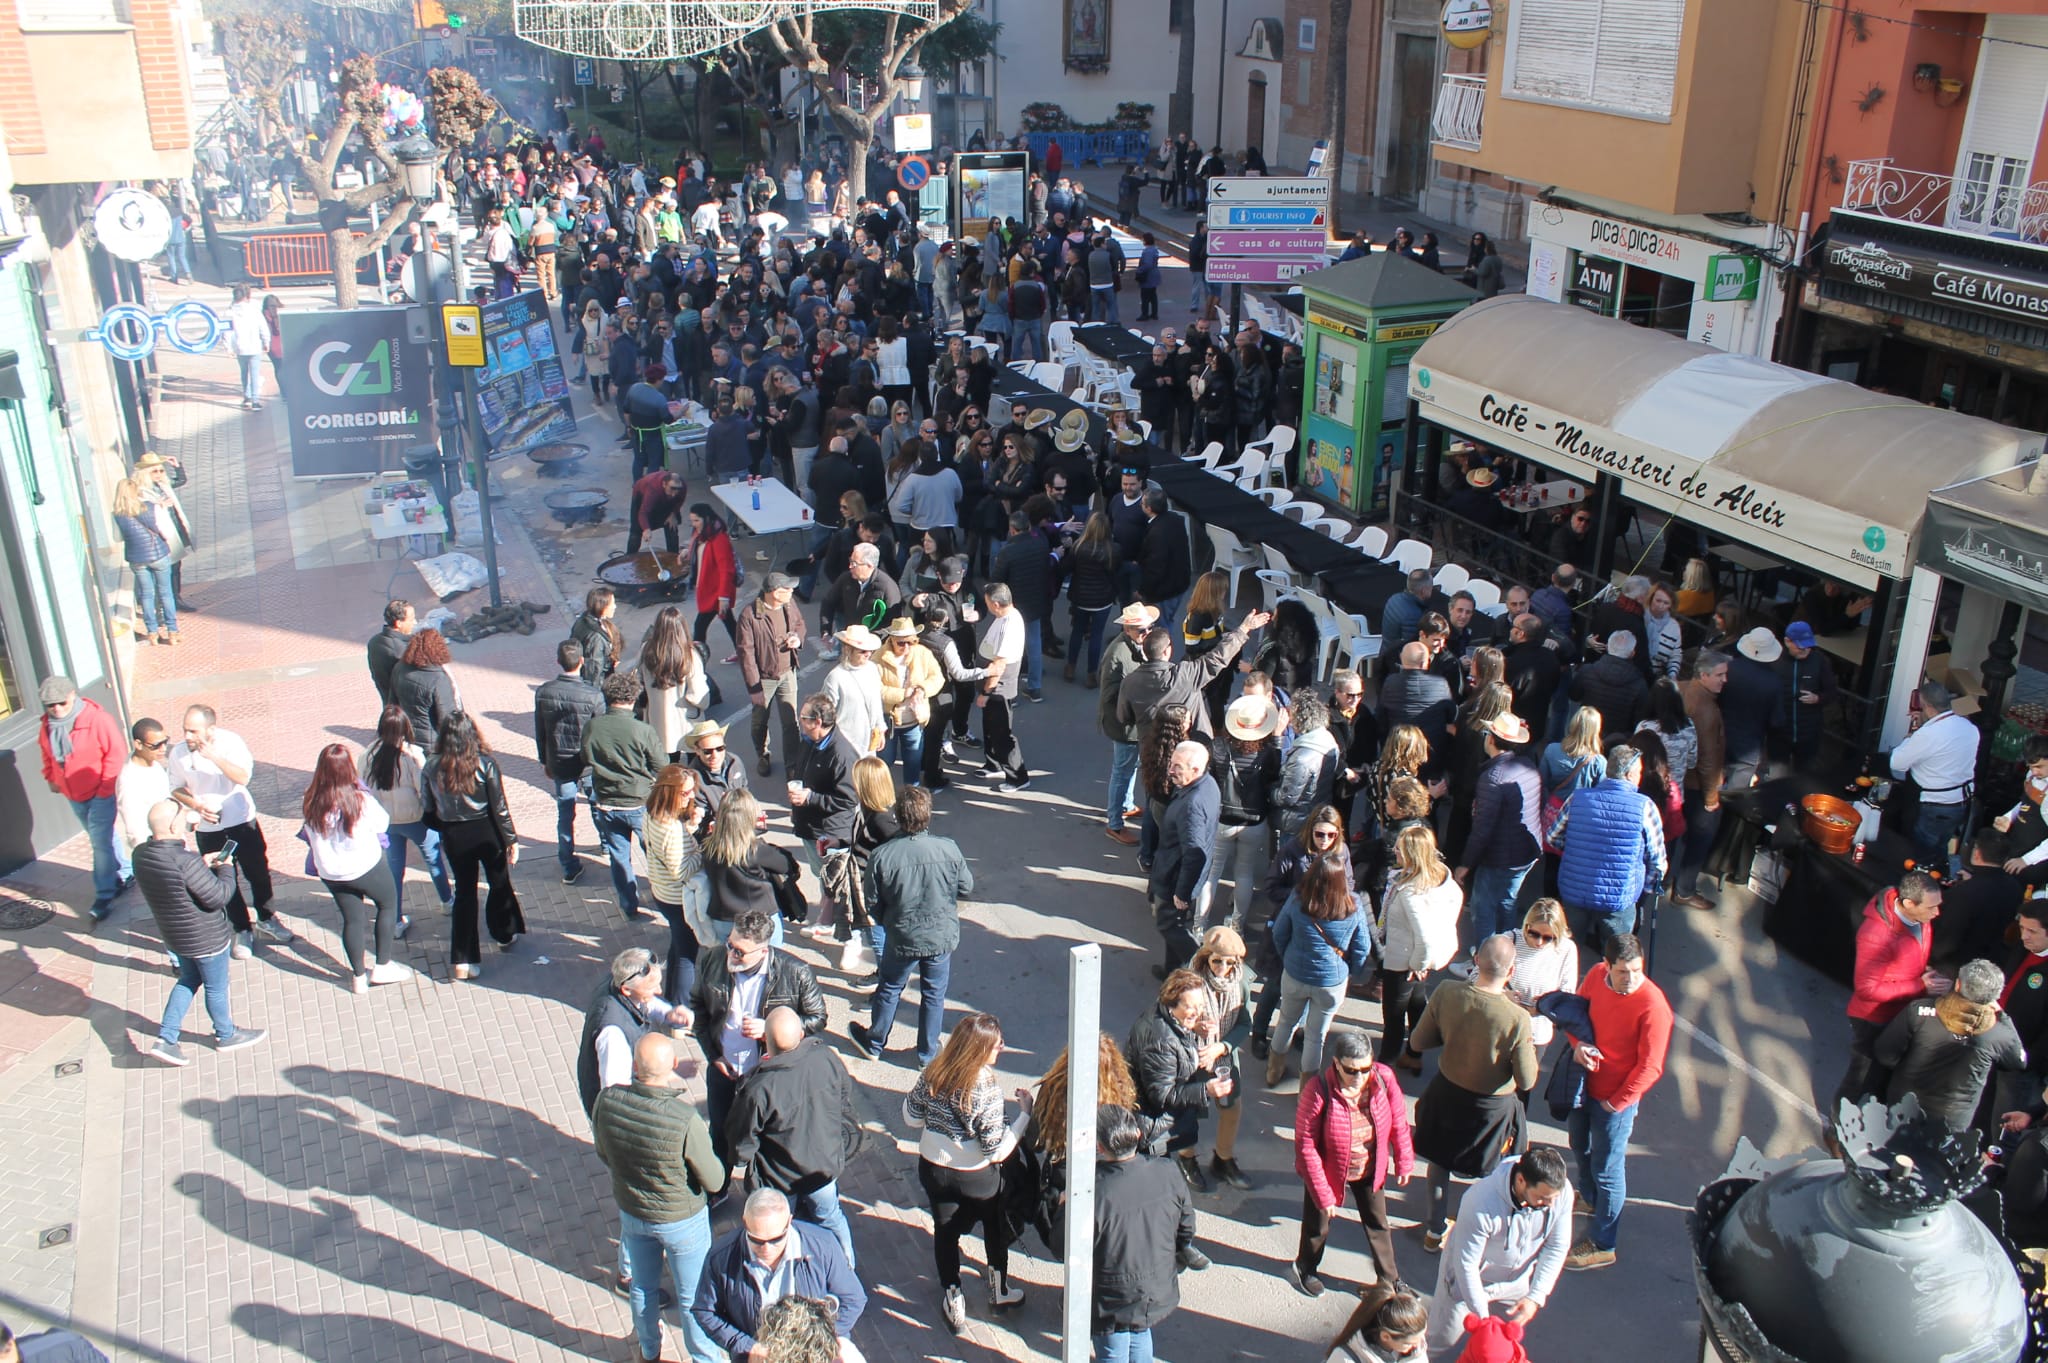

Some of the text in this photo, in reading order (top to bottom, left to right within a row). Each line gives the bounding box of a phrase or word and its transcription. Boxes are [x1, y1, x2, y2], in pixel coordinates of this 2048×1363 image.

[1266, 186, 1327, 196] ajuntament
[1238, 239, 1324, 248] casa de cultura
[1841, 252, 1902, 277] Monasteri
[1208, 272, 1250, 280] municipal
[1579, 266, 1613, 293] ATM
[1715, 272, 1744, 286] ATM
[1854, 272, 1887, 290] Aleix
[1932, 271, 1977, 298] Café
[1480, 393, 1529, 433] Café
[1554, 421, 1676, 487] Monasteri
[1679, 469, 1708, 499] de
[1713, 483, 1787, 529] Aleix
[1918, 1005, 1936, 1017] HH
